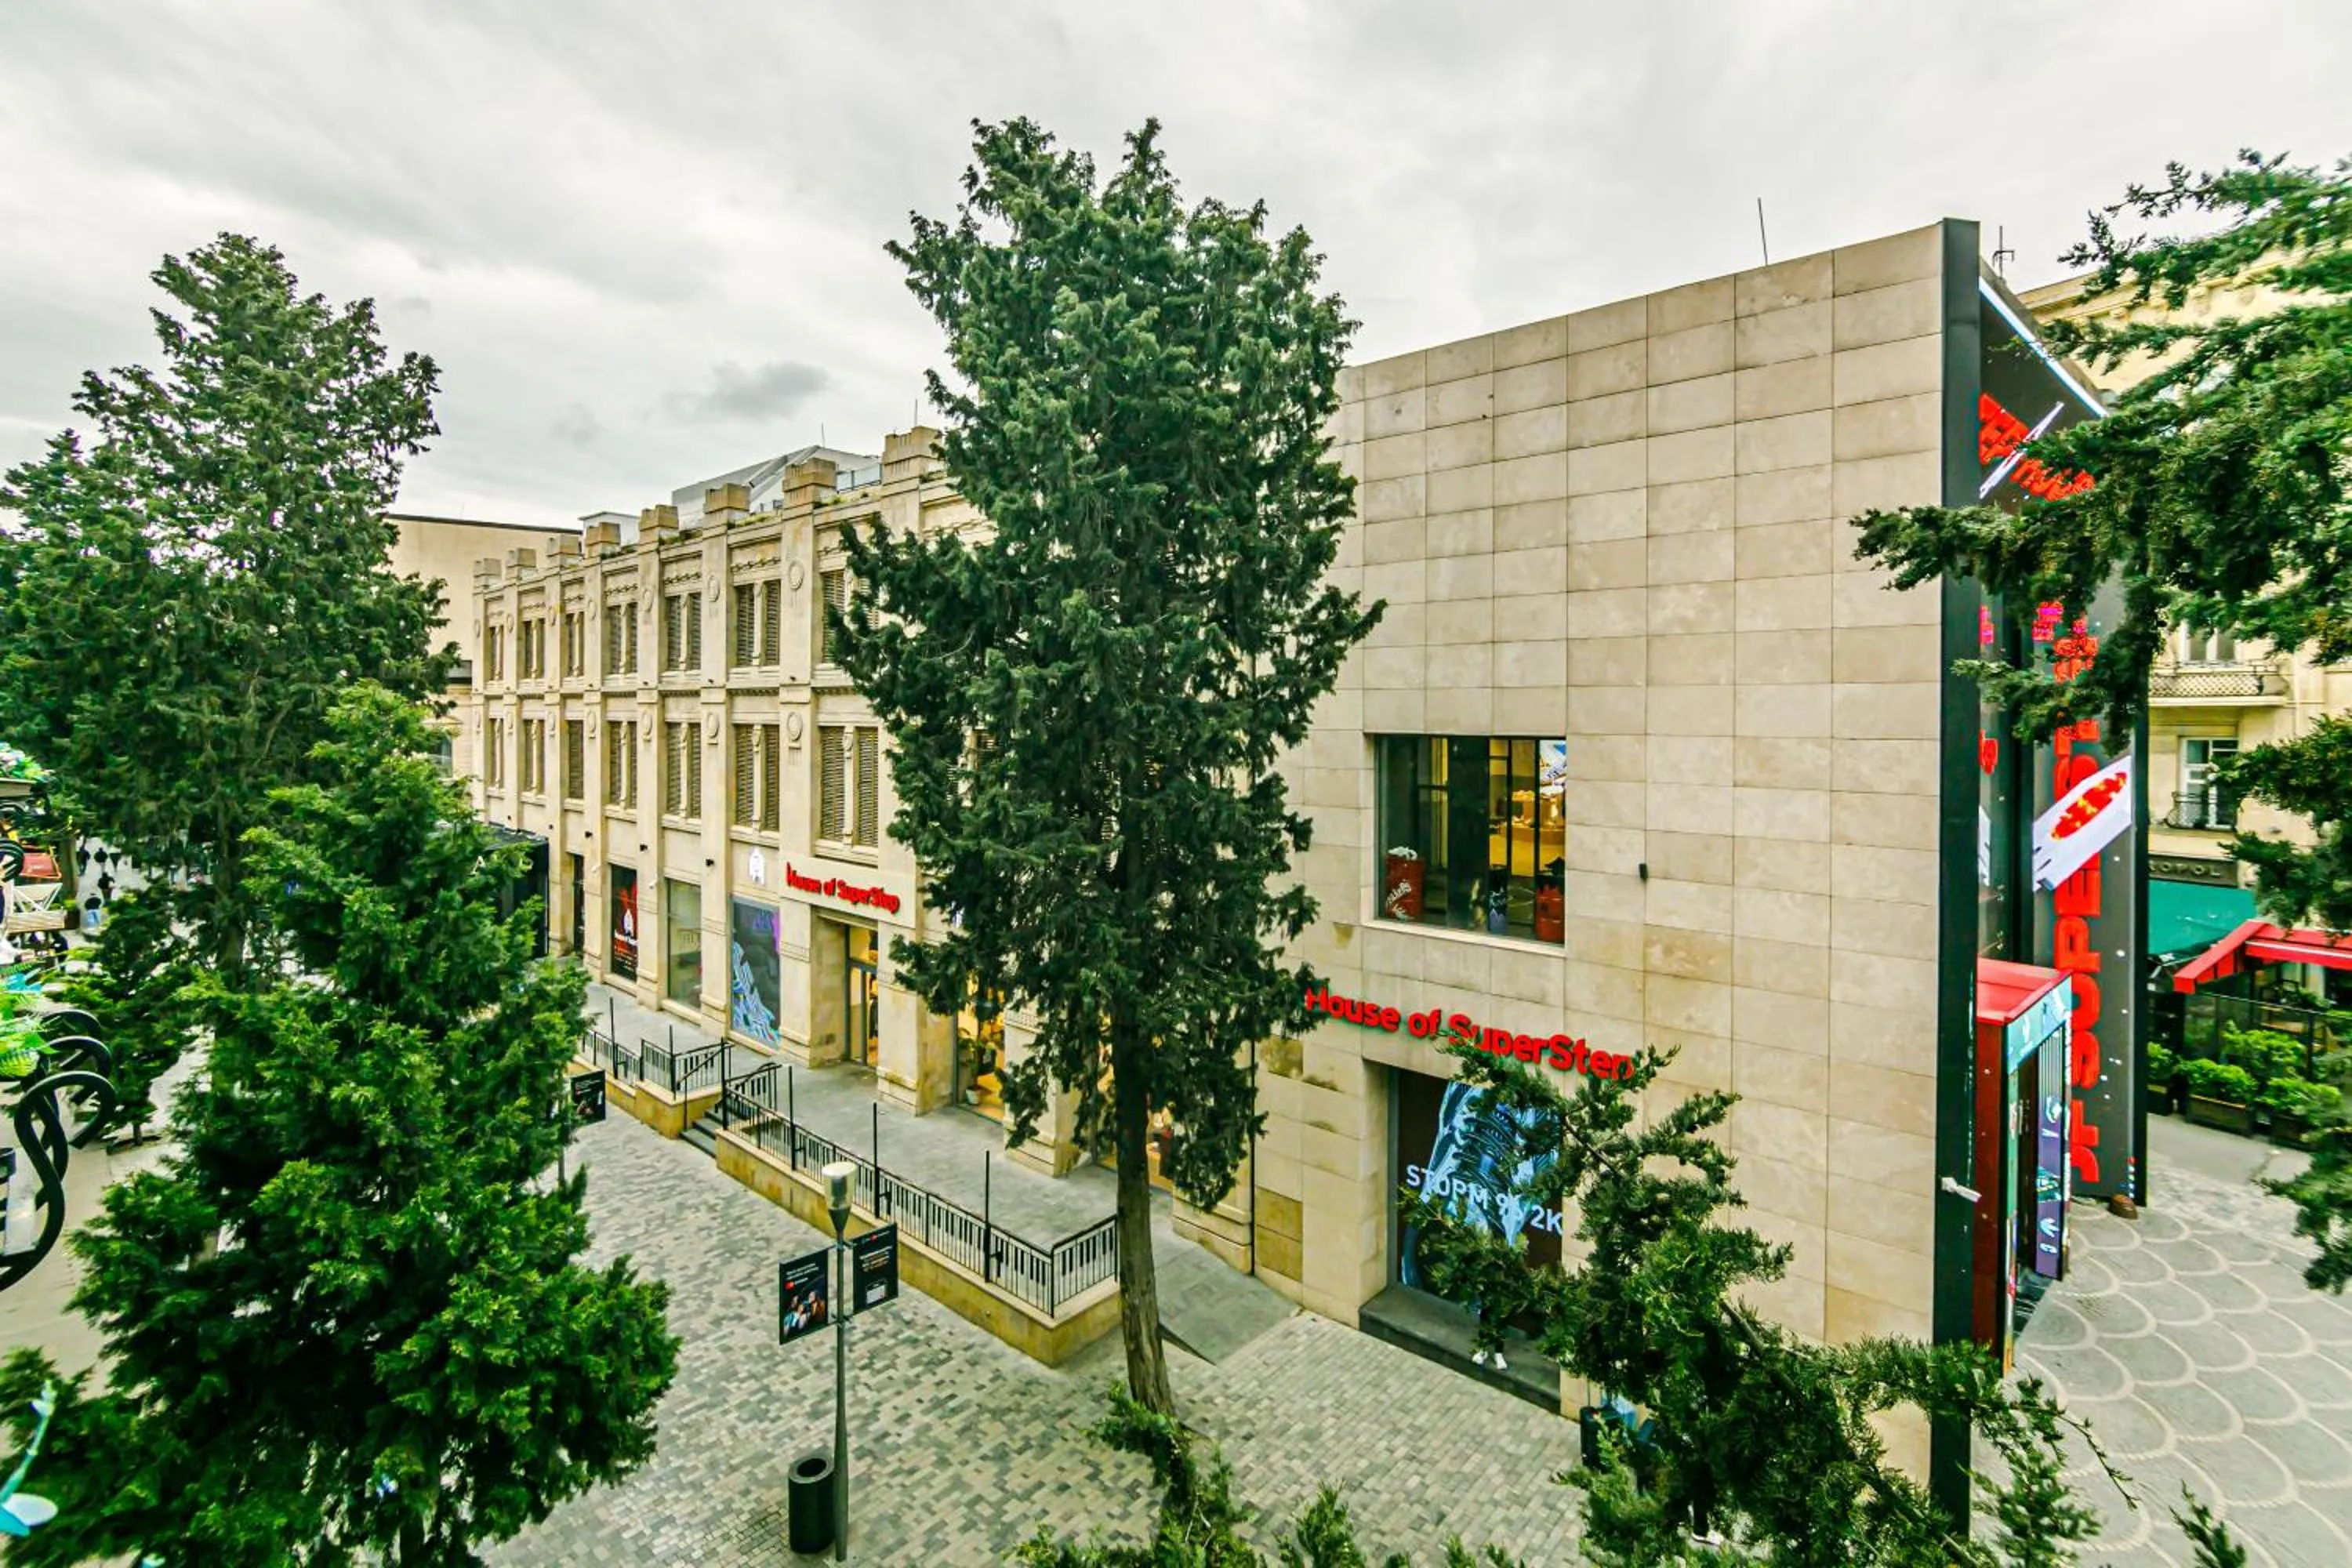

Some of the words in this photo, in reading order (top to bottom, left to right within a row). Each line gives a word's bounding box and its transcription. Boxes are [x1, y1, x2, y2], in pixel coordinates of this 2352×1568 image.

[786, 862, 822, 894] House
[823, 878, 837, 896] of
[837, 880, 901, 915] SuperStep
[2149, 861, 2221, 876] OPOL
[1305, 985, 1401, 1033] House
[1408, 1008, 1441, 1040] of
[1530, 1204, 1563, 1236] 2K
